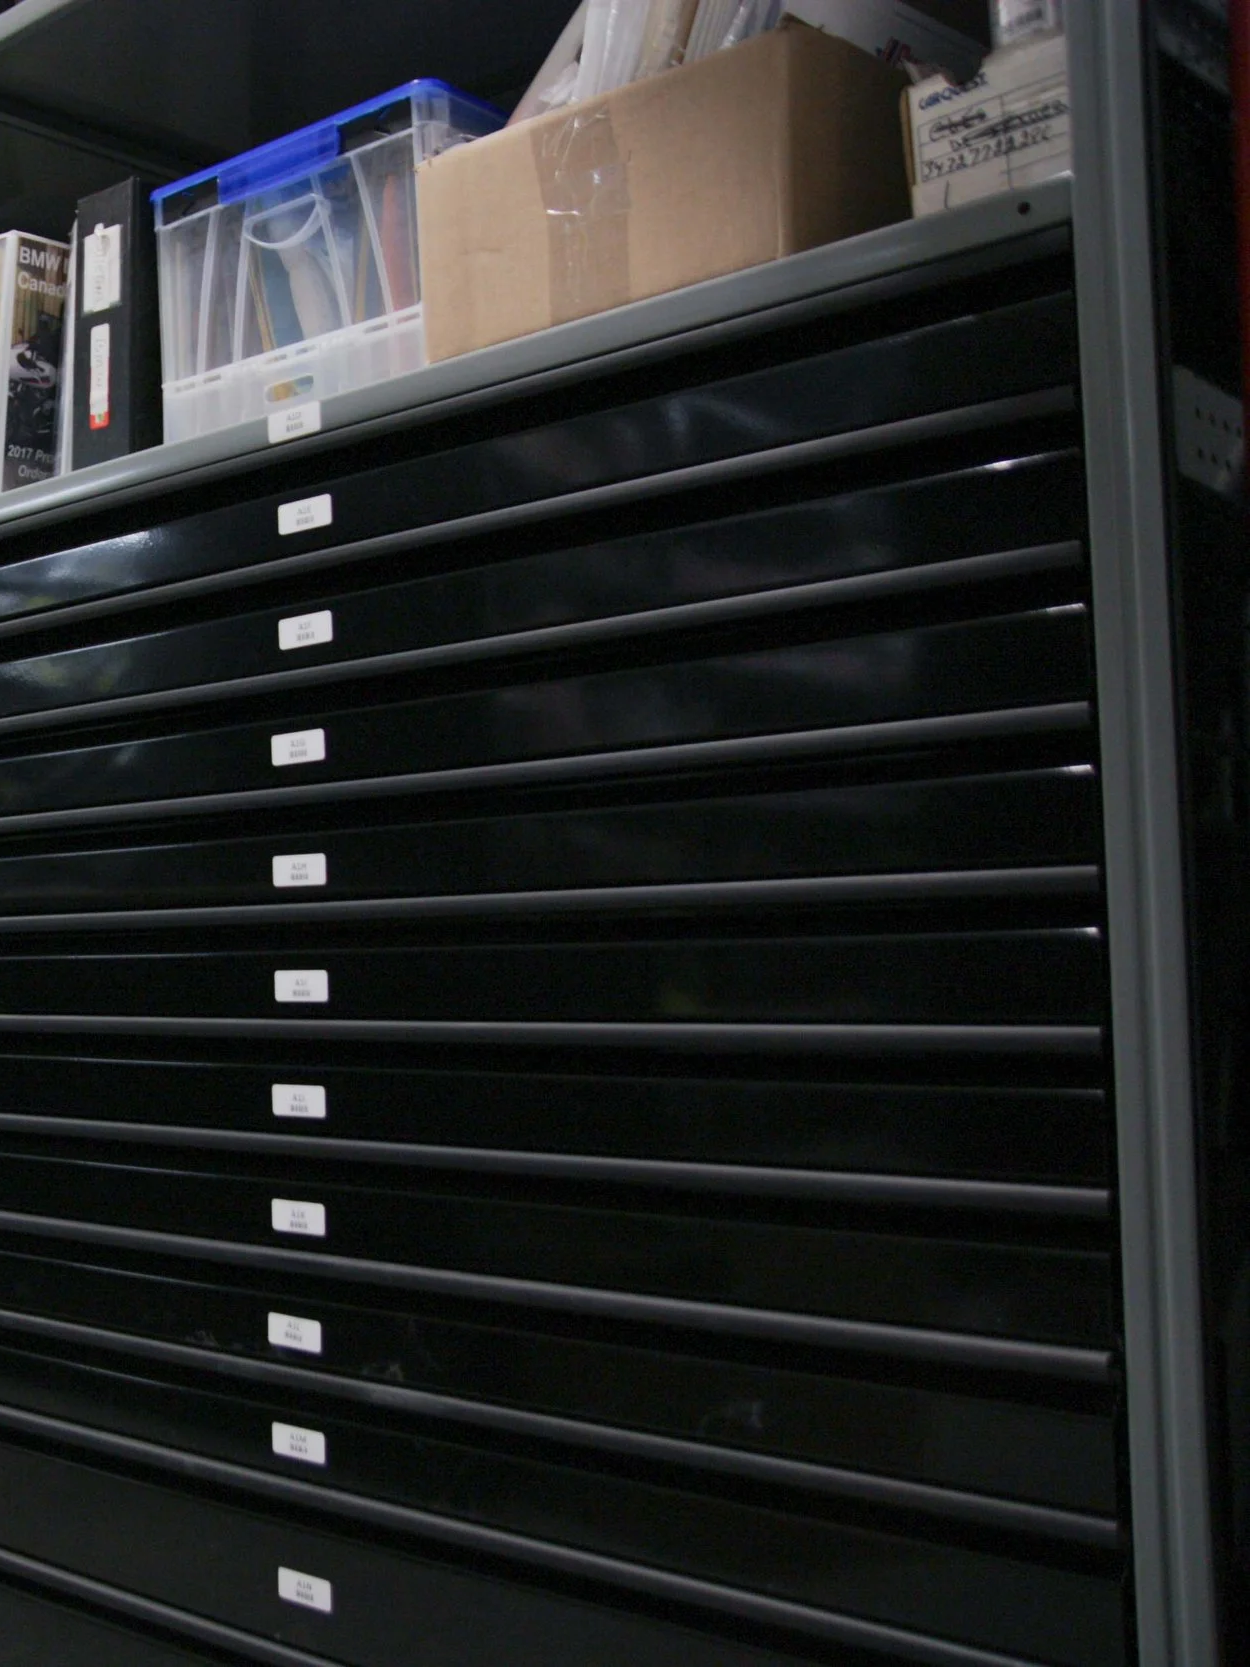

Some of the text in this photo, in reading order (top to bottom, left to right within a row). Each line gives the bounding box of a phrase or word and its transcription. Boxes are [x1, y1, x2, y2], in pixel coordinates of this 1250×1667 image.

[19, 245, 62, 271] BMW
[18, 271, 71, 297] Canad
[7, 444, 33, 460] 2017
